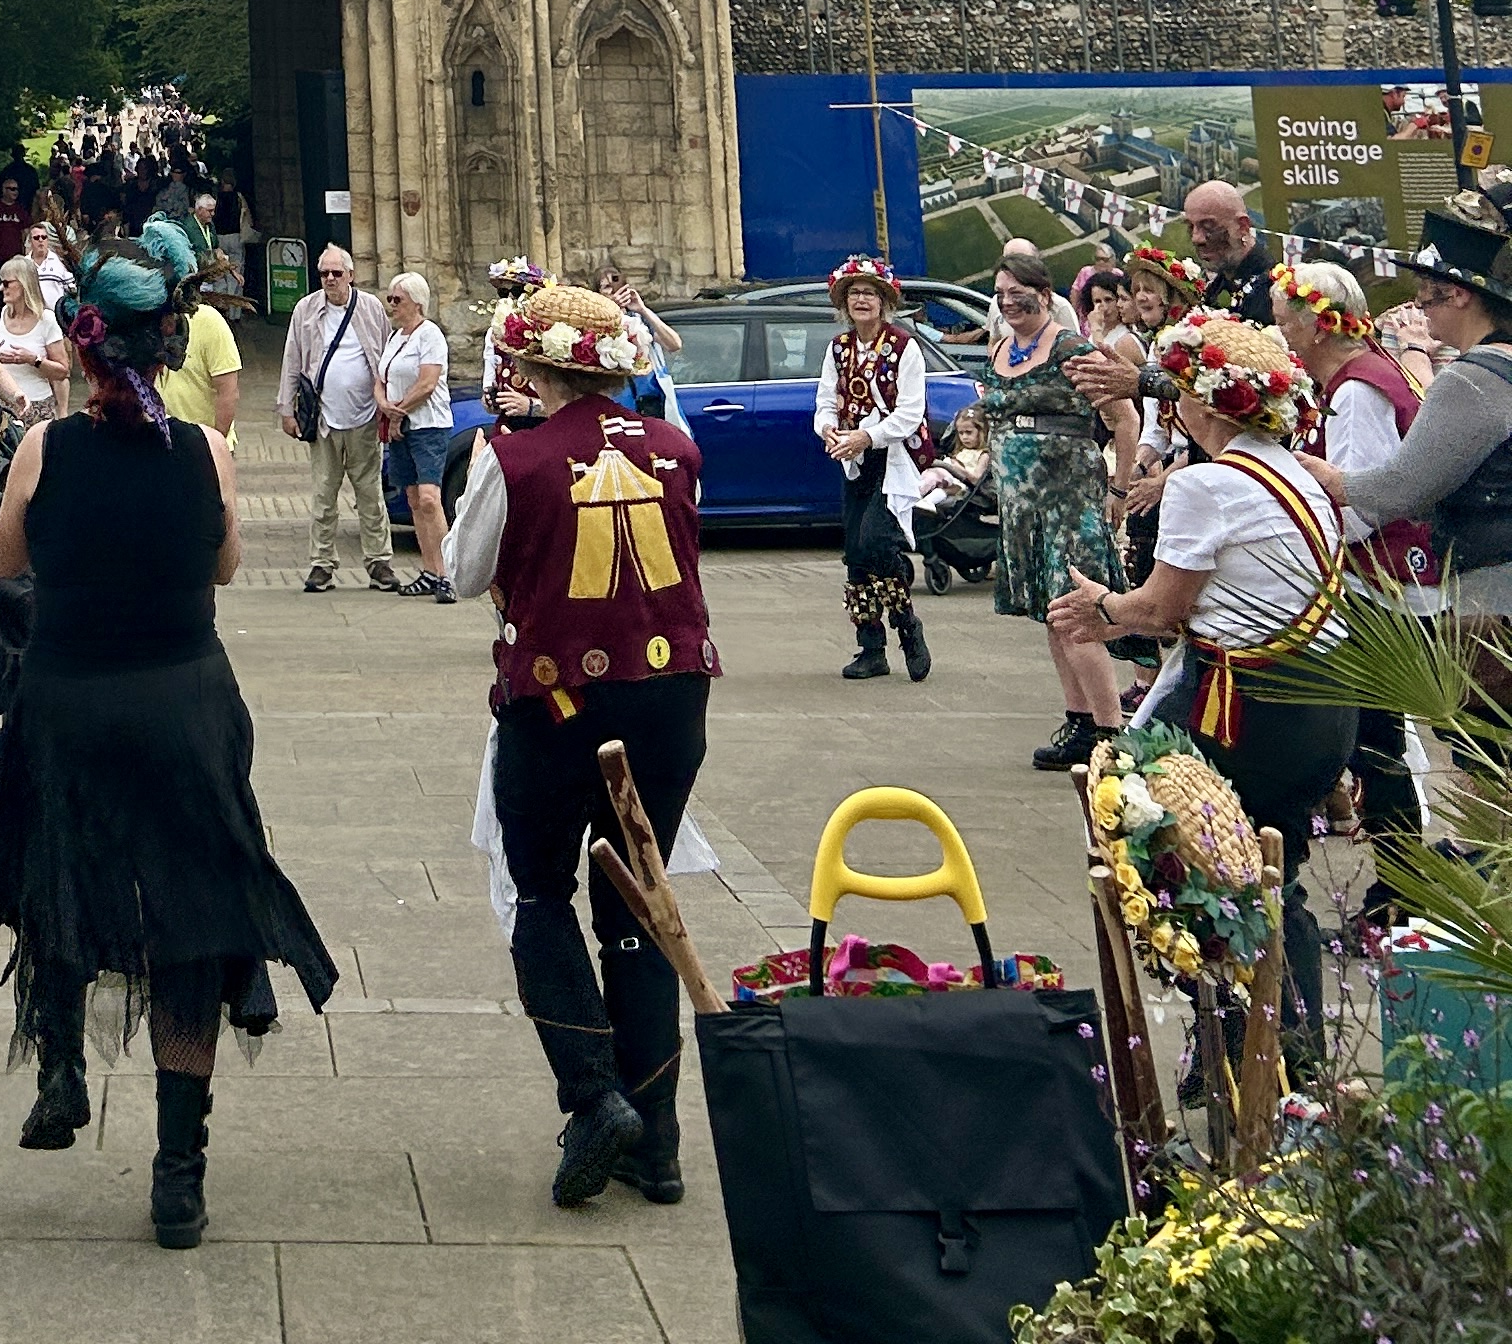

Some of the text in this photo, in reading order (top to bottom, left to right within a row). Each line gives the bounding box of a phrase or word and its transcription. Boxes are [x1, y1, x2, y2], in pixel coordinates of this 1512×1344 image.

[1277, 115, 1358, 141] Saving
[1280, 140, 1383, 165] heritage
[1283, 164, 1340, 185] skills
